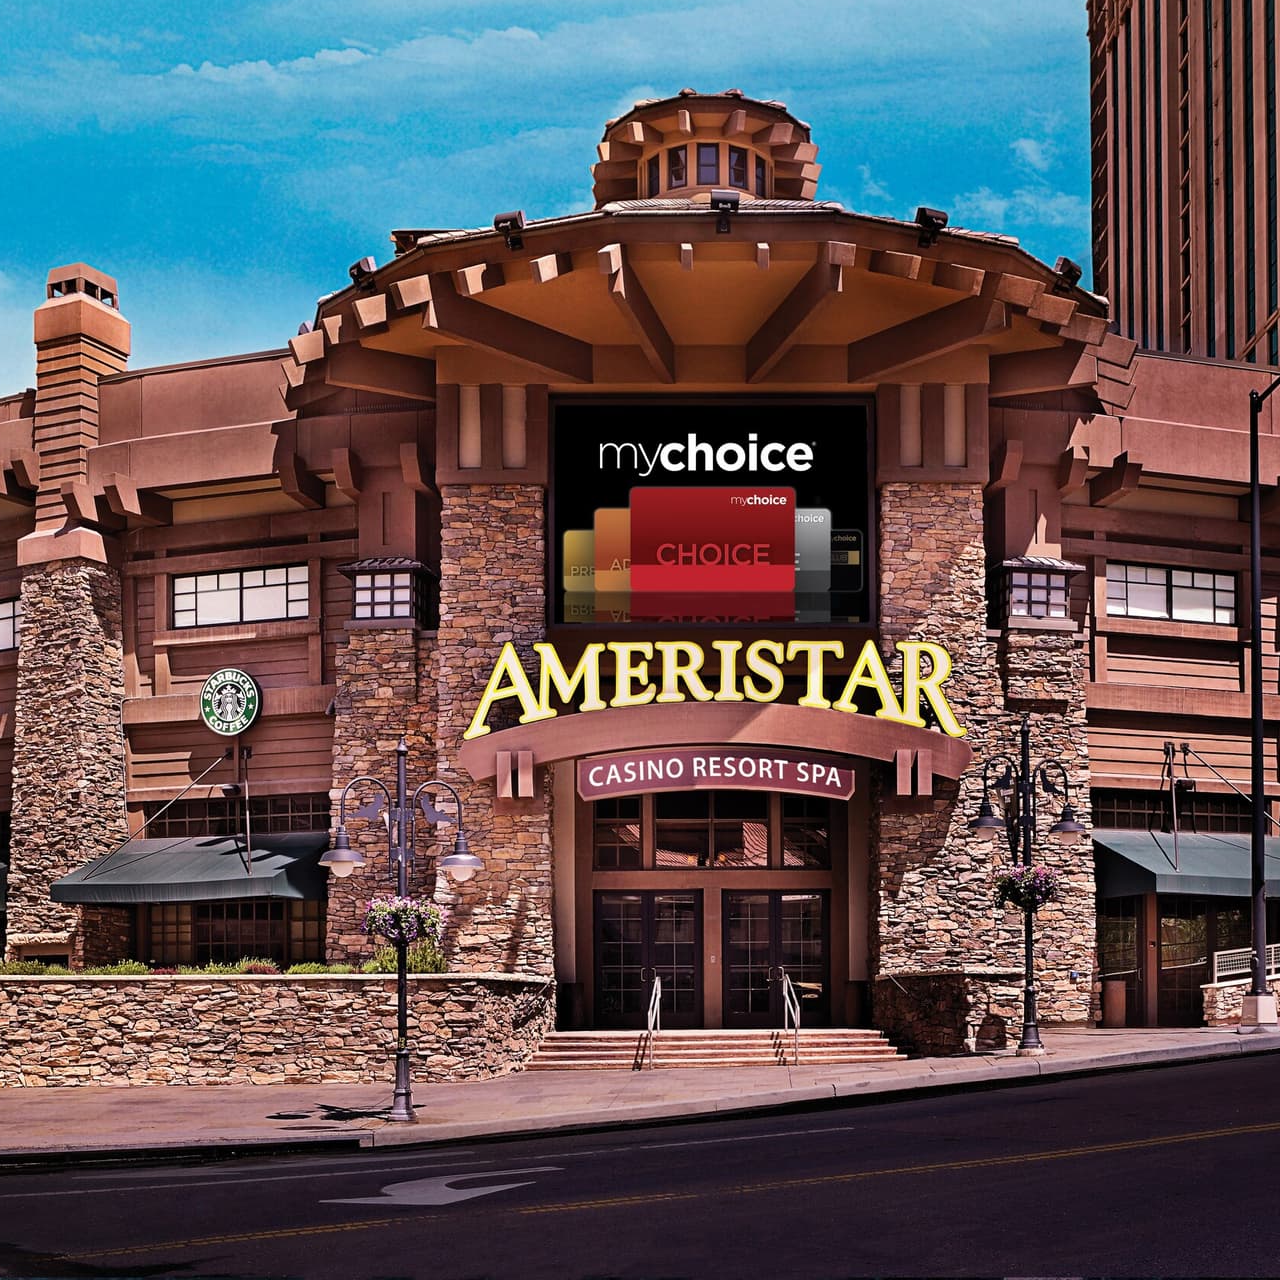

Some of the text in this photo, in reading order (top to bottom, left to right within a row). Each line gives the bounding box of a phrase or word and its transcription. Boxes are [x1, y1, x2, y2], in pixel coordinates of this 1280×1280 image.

[599, 433, 814, 477] mychoice
[730, 494, 788, 507] mychoice
[656, 543, 771, 566] CHOICE
[203, 671, 255, 701] STARBUCKS
[463, 639, 968, 740] AMERISTAR
[209, 714, 249, 732] COFFEE
[588, 756, 842, 788] CASINO RESORT SPA
